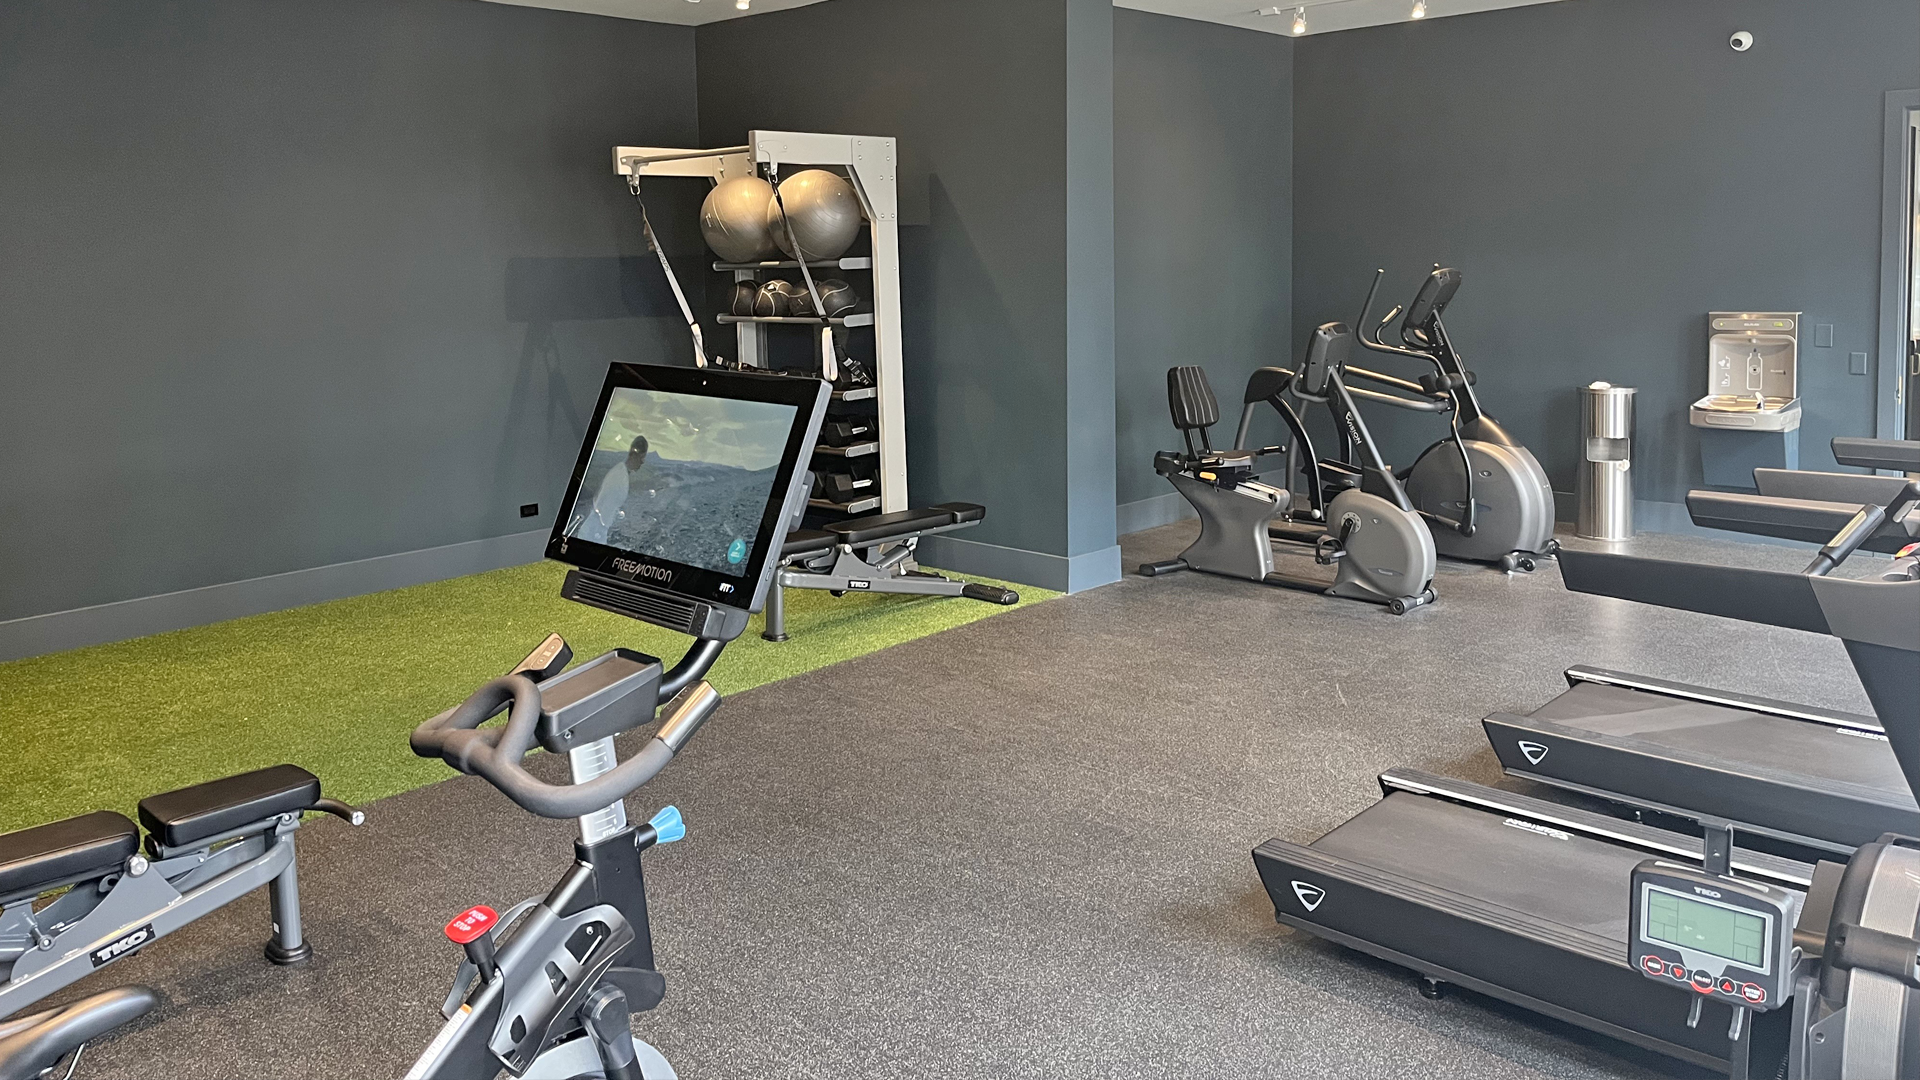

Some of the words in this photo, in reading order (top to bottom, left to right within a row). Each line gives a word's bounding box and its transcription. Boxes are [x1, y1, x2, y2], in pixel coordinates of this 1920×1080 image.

[612, 557, 672, 582] FREEMOTION
[1693, 886, 1722, 899] TKO
[453, 920, 472, 932] STOP
[96, 930, 148, 962] TKO
